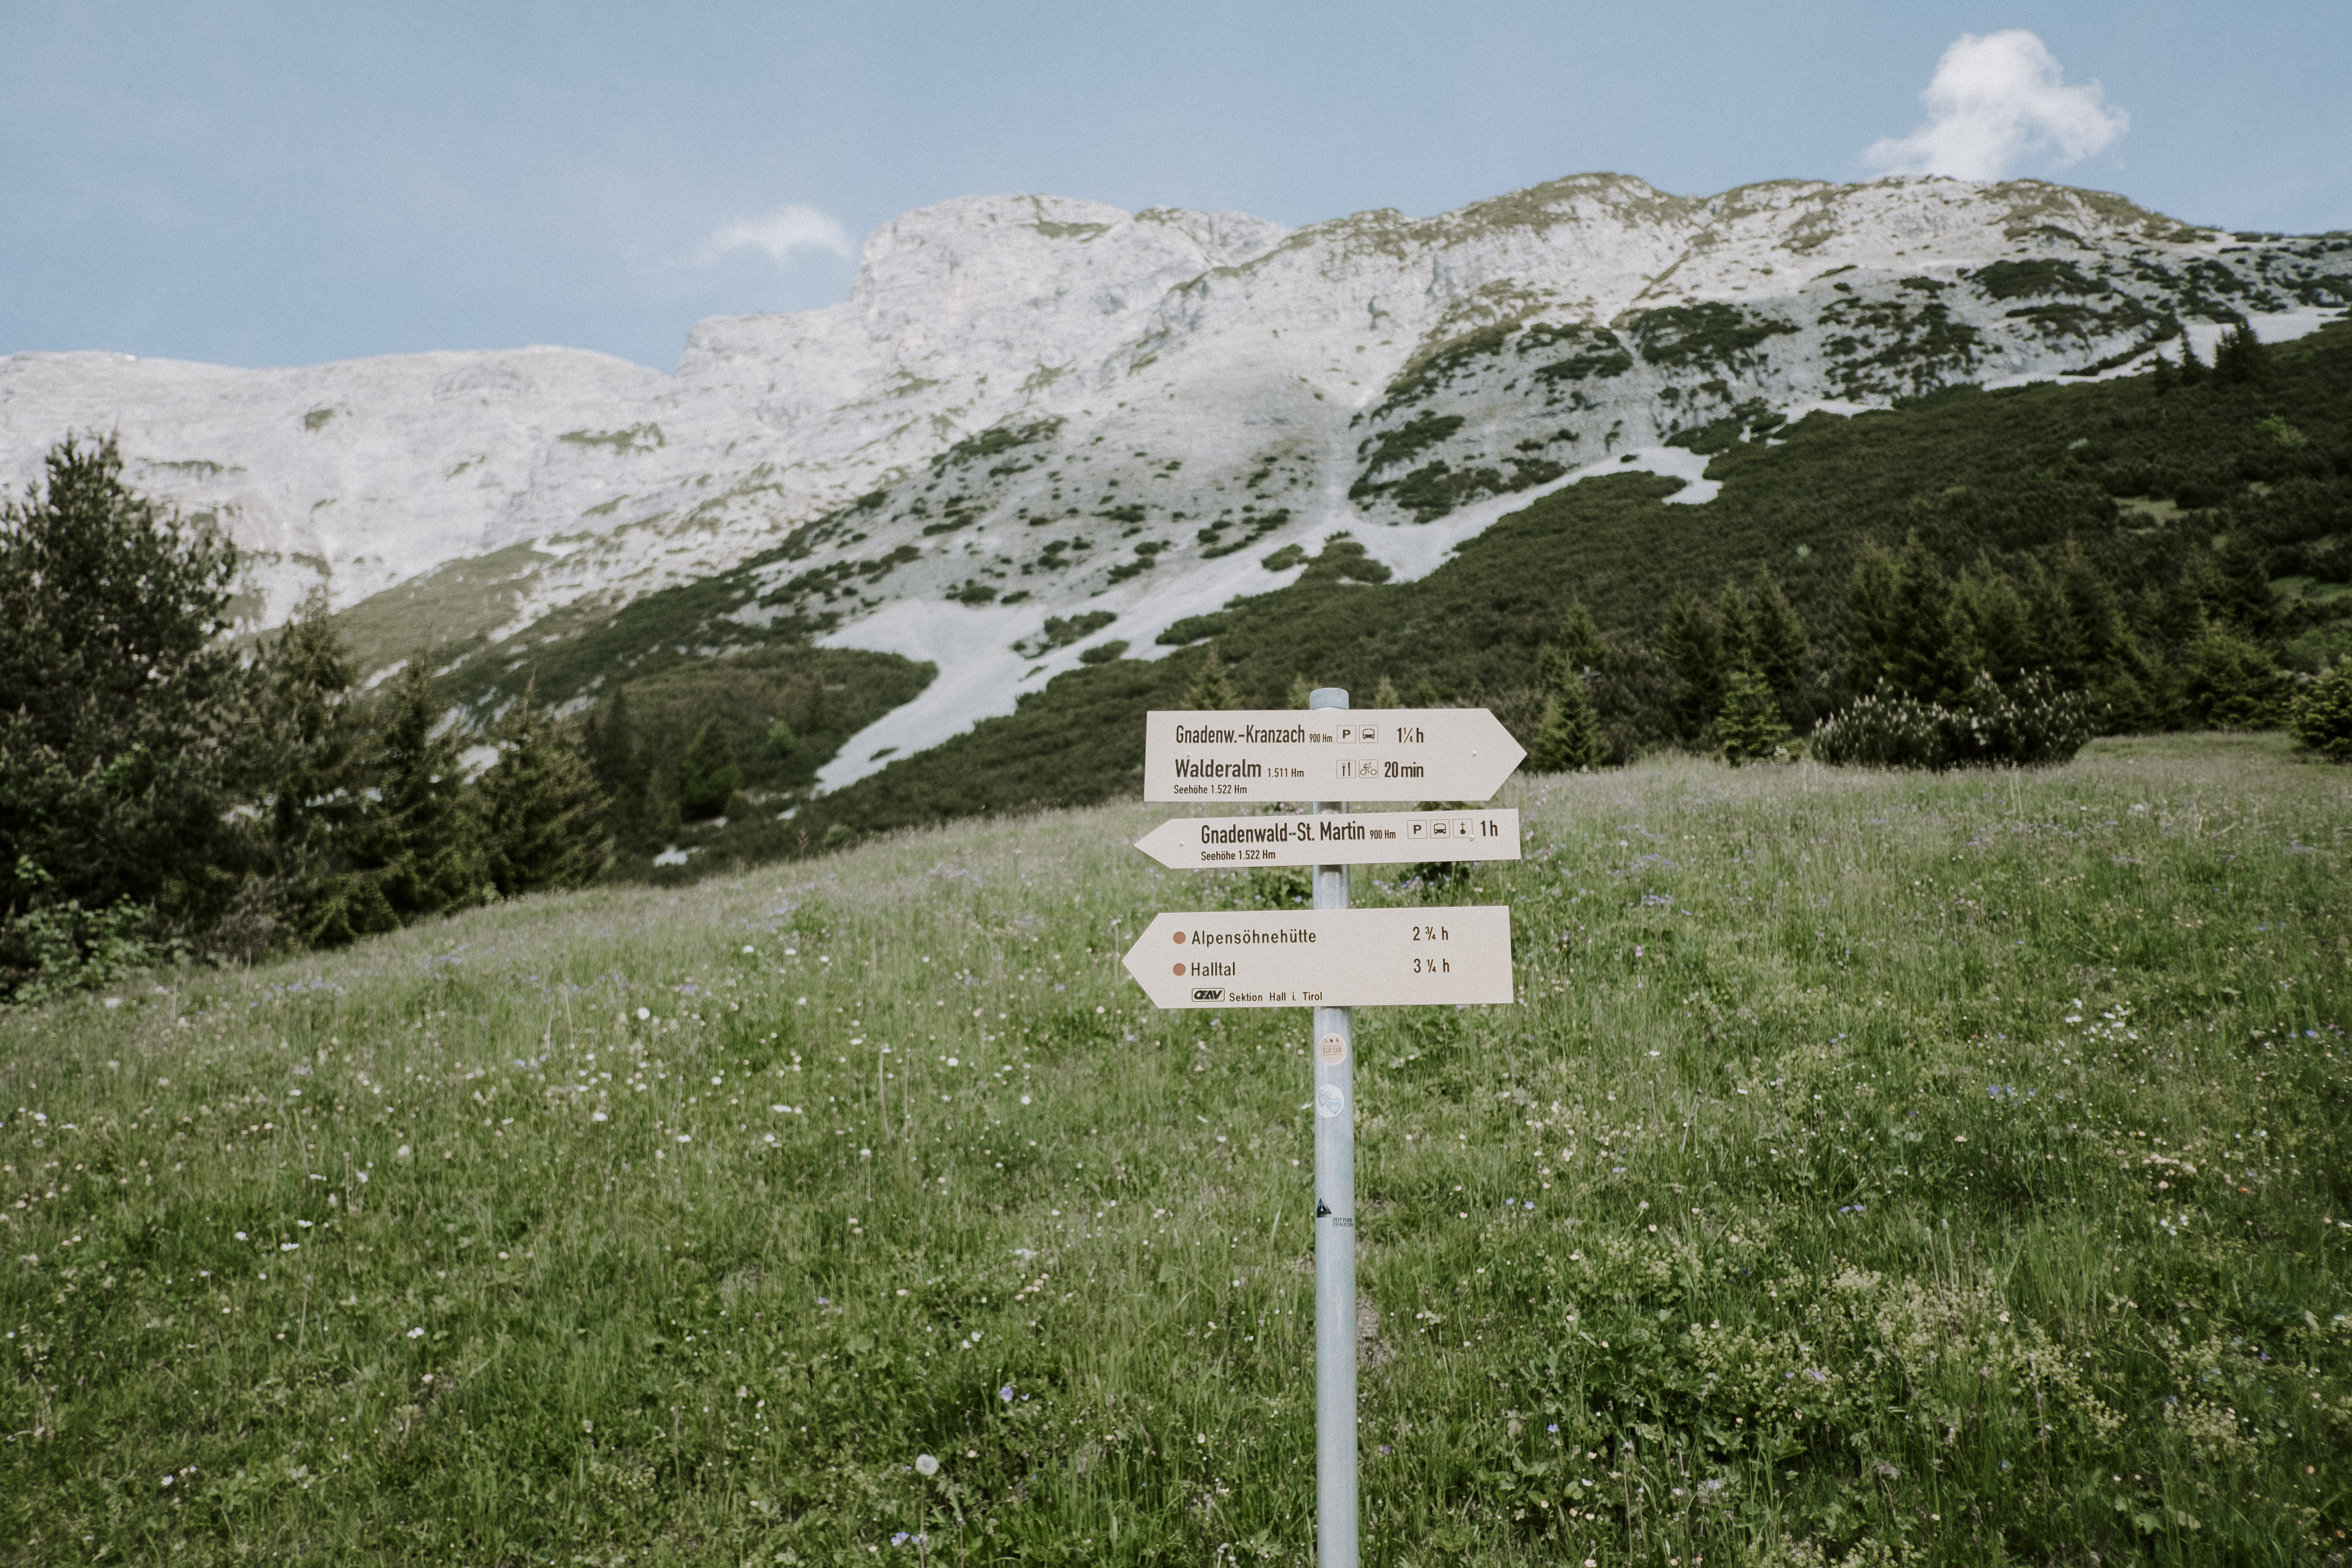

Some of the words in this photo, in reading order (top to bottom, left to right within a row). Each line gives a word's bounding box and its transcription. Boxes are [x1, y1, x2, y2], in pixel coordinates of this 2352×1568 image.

[1176, 724, 1305, 744] Gnadenw.-Kranzach
[1309, 734, 1321, 743] 900
[1323, 733, 1332, 743] Hm
[1343, 730, 1351, 739] P
[1416, 727, 1424, 743] h
[1175, 759, 1261, 778] Walderalm
[1267, 768, 1288, 777] 1.511
[1291, 768, 1304, 777] Hm
[1384, 761, 1399, 778] 20
[1401, 761, 1424, 778] min
[1174, 784, 1208, 794] Seehöhe
[1211, 784, 1232, 794] 1.522
[1234, 784, 1247, 794] Hm
[1201, 822, 1315, 844] Gnadenwald-St.
[1320, 821, 1365, 841] Martin
[1370, 829, 1383, 839] 900
[1385, 829, 1396, 839] Hm
[1413, 824, 1422, 834] P
[1481, 820, 1486, 837] 1
[1490, 820, 1498, 837] h
[1201, 851, 1236, 861] Seehöhe
[1238, 850, 1260, 860] 1.522
[1263, 849, 1276, 859] Hm
[1192, 929, 1316, 948] Alpensöhnehütte
[1441, 926, 1448, 940] h
[1191, 962, 1235, 976] Halltal
[1443, 958, 1450, 973] h
[1229, 993, 1263, 1002] Sektion
[1269, 992, 1286, 1001] Hall
[1292, 992, 1296, 1001] i.
[1303, 992, 1322, 1001] Tirol
